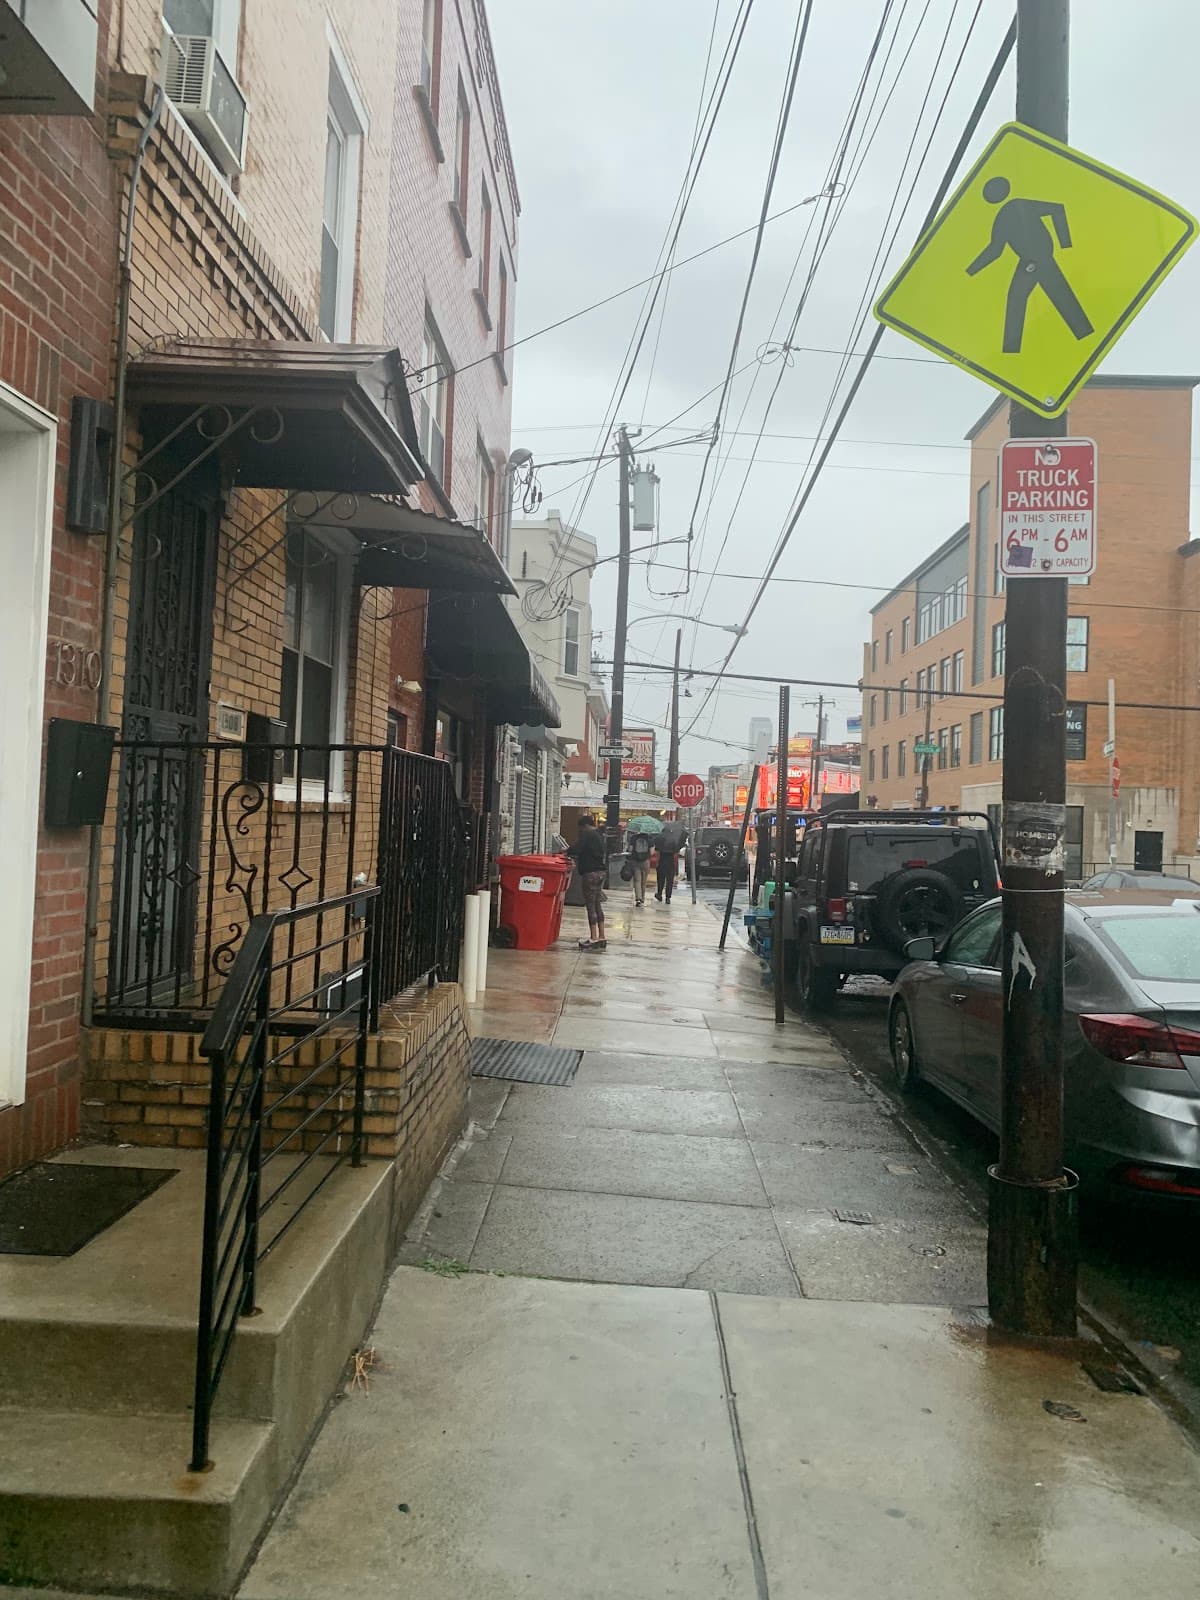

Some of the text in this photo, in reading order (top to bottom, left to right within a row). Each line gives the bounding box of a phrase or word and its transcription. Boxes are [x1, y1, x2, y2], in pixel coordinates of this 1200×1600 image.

[1034, 448, 1061, 466] NO
[1016, 468, 1080, 487] TRUCK
[1007, 489, 1089, 508] PARKING
[1008, 513, 1086, 523] IN THIS STREET
[1056, 557, 1089, 567] CAPACITY
[55, 641, 102, 689] 1310
[674, 784, 703, 798] STOP
